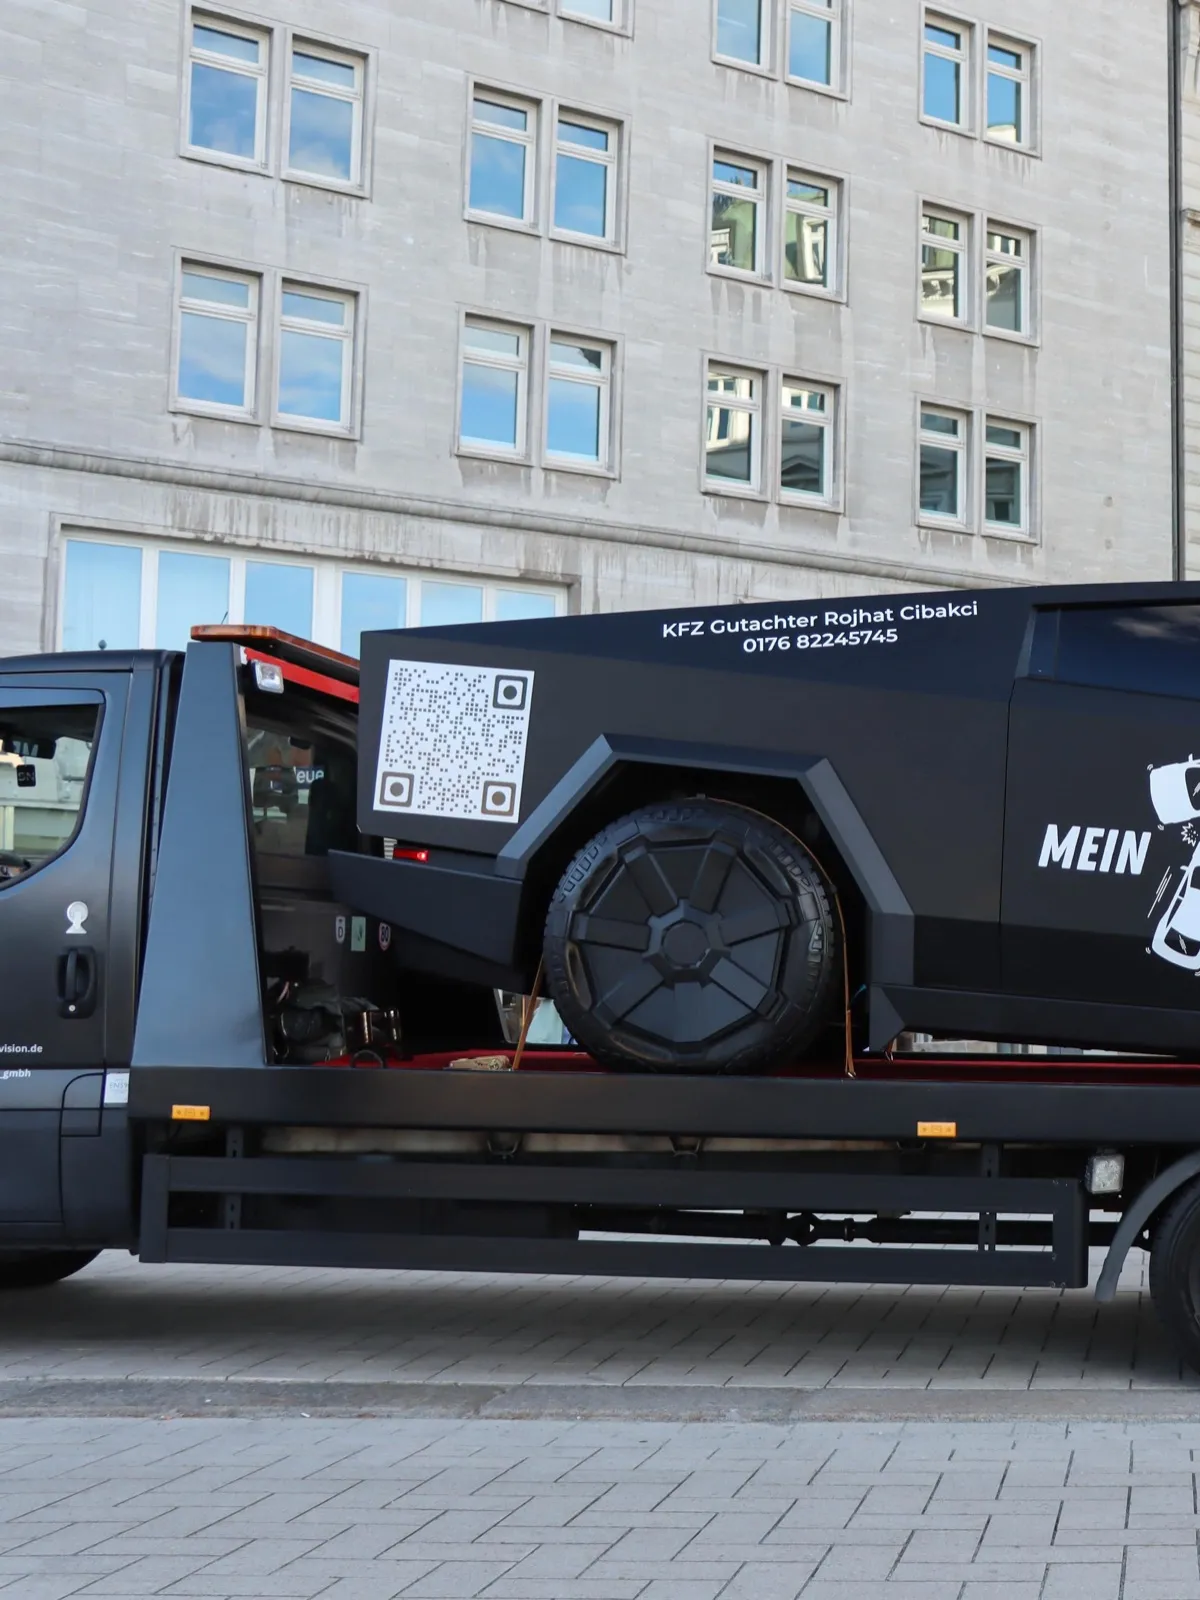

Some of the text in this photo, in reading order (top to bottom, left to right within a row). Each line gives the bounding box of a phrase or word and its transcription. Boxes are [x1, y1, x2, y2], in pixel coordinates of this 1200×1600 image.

[662, 600, 978, 638] KFZ Gutachter Rojhat Cibakci
[742, 628, 899, 653] 0176 82245745
[1037, 823, 1152, 875] MEIN
